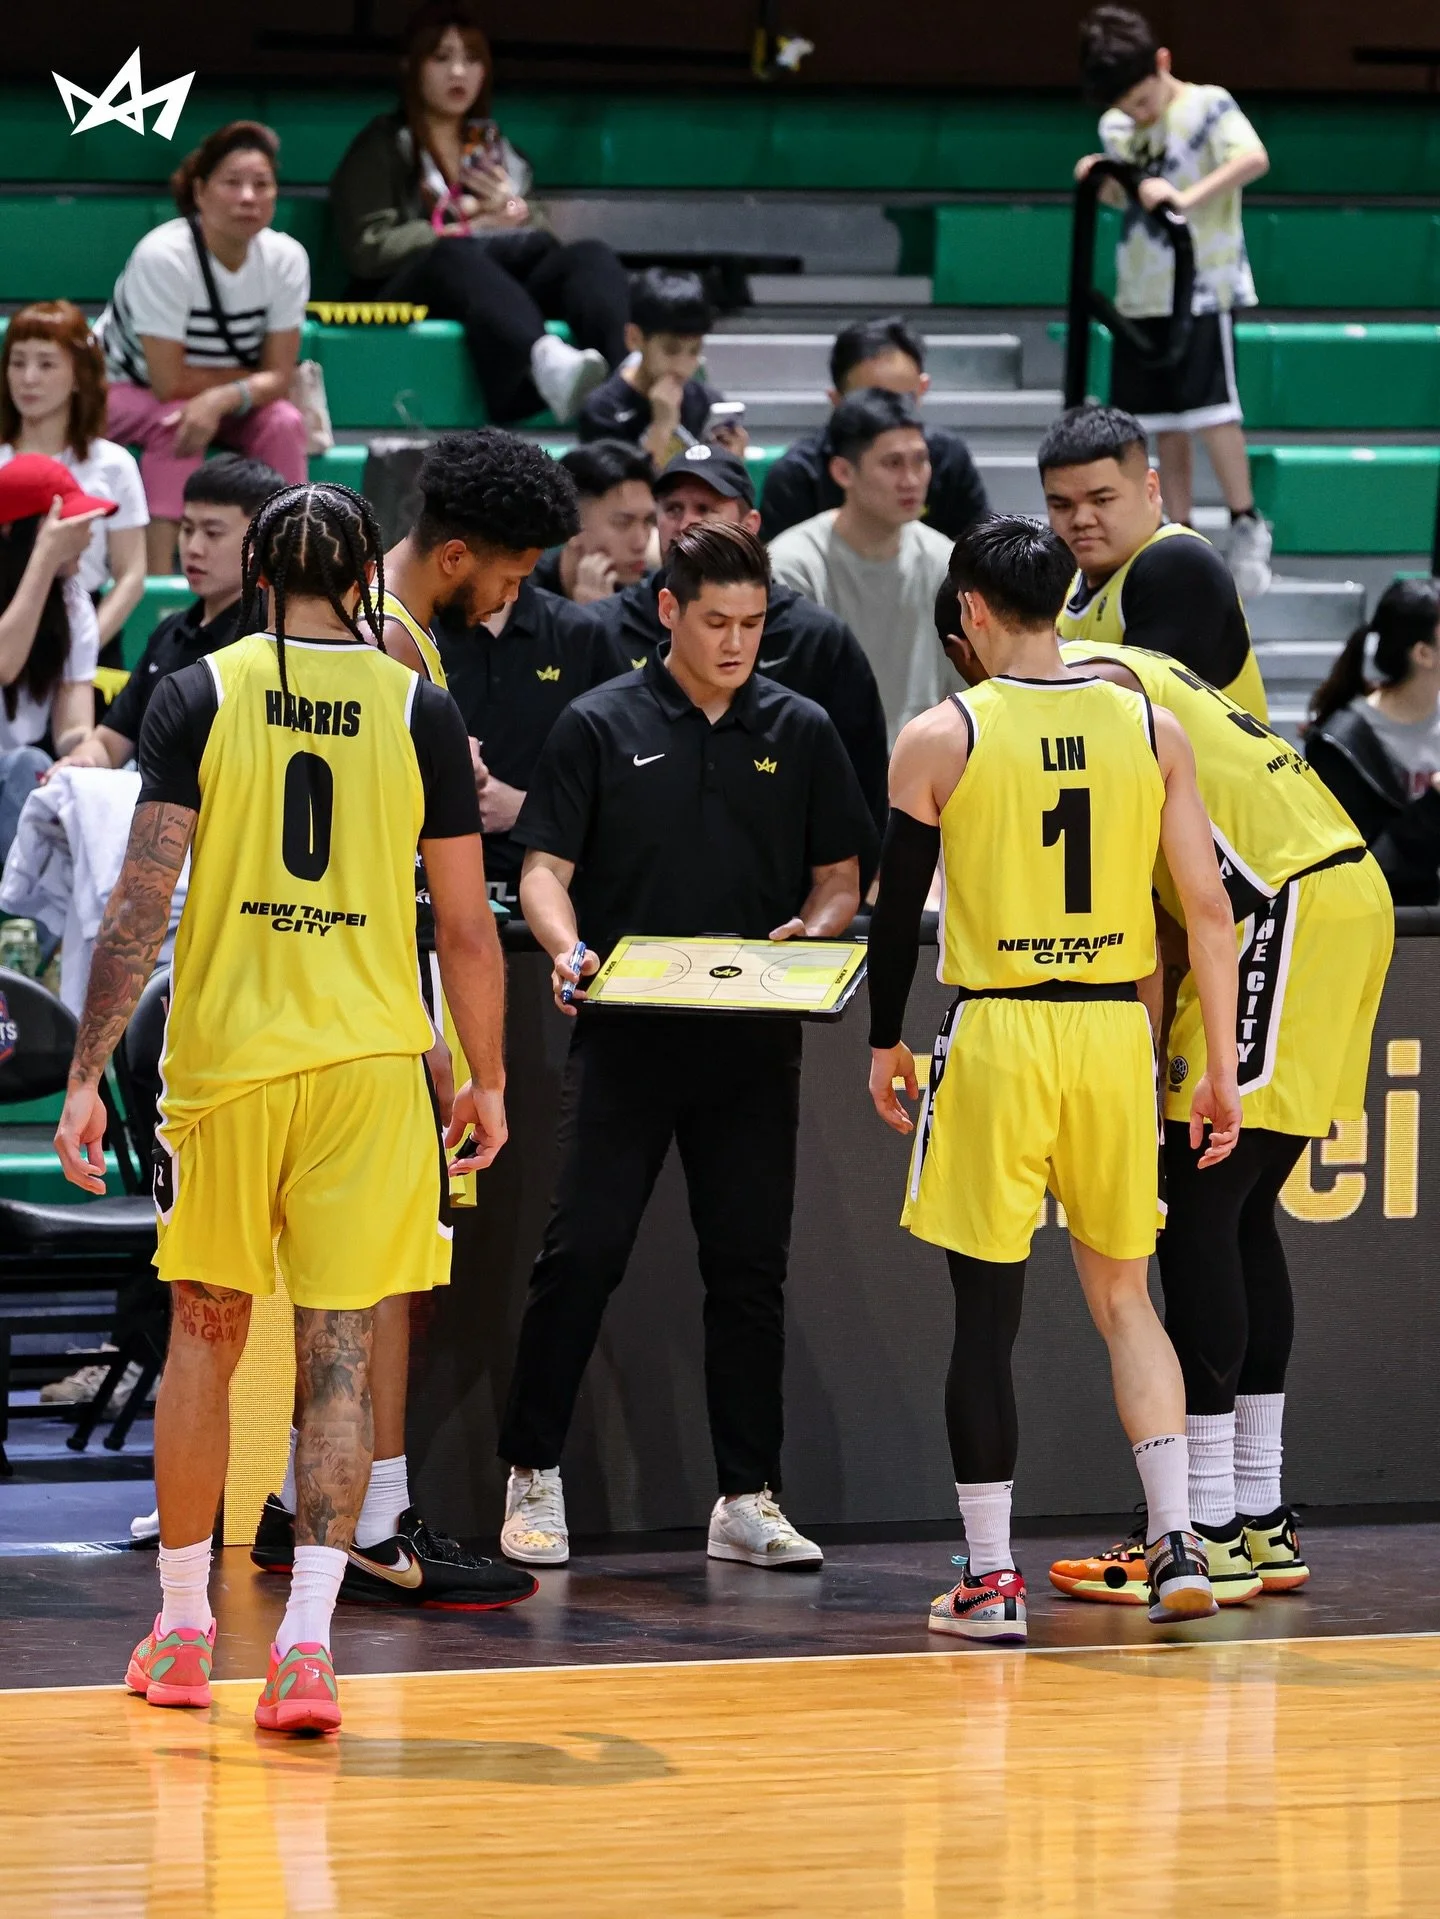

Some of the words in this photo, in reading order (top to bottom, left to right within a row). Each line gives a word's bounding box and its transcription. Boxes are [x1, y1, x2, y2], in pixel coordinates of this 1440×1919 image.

[265, 690, 361, 737] HARRIS
[1041, 735, 1086, 771] LIN
[282, 750, 333, 882] 0
[1042, 788, 1092, 914] 1
[240, 901, 297, 917] NEW
[300, 905, 367, 927] TAIPEI
[271, 918, 332, 937] CITY
[1252, 899, 1277, 962] HE
[997, 938, 1056, 951] NEW
[1059, 932, 1124, 950] TAIPEI
[1034, 951, 1099, 964] CITY
[1237, 971, 1266, 1063] CITY
